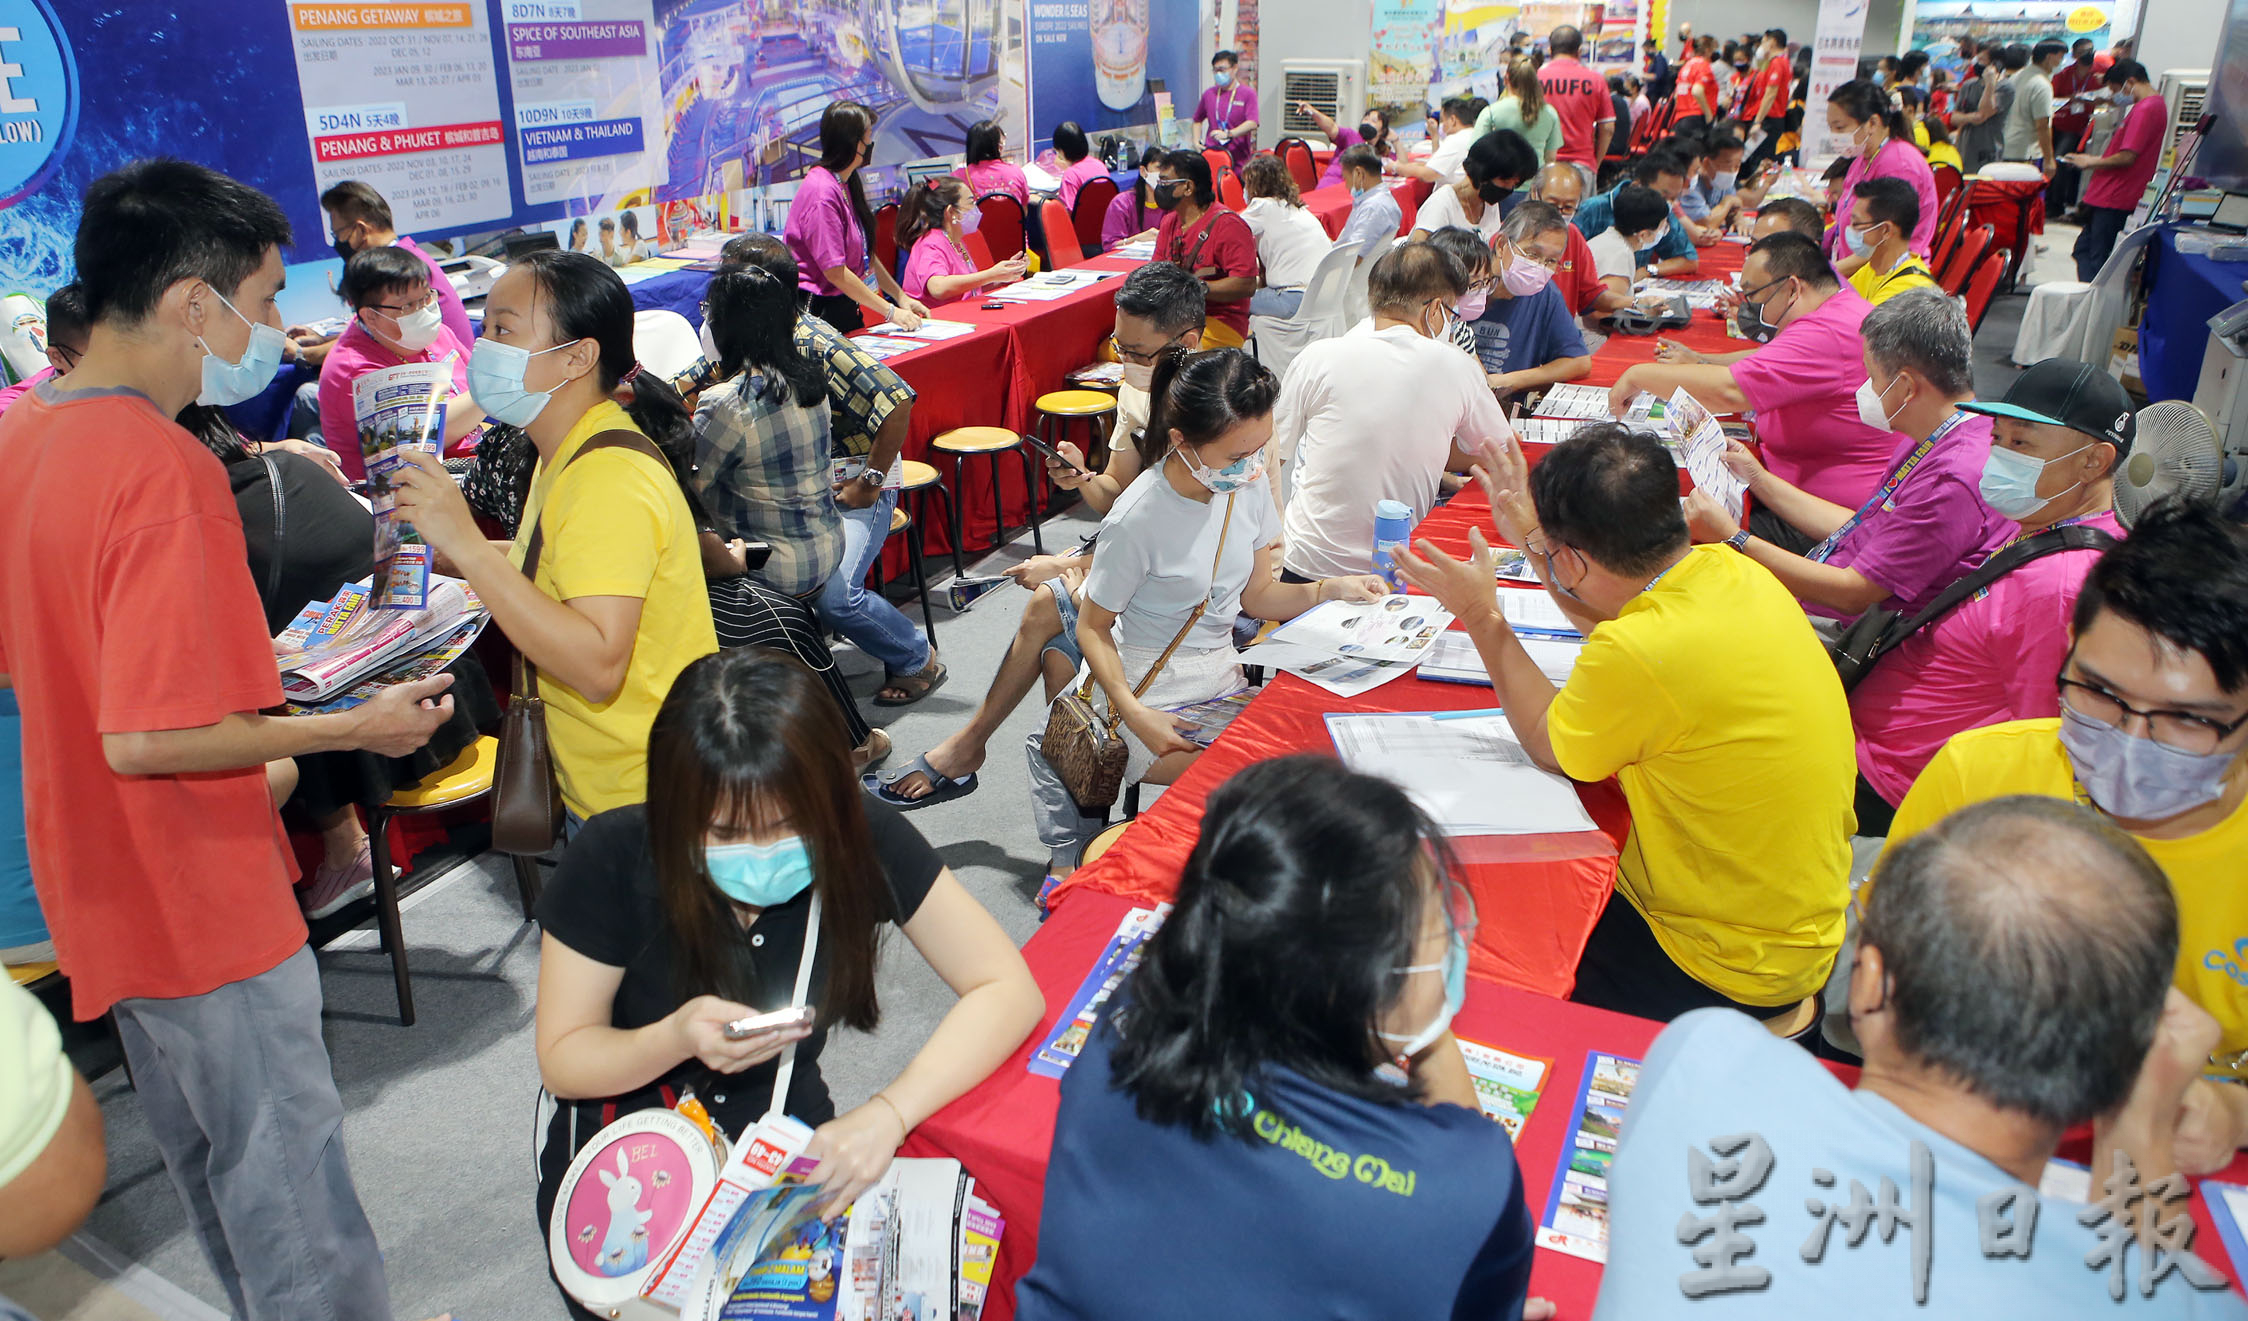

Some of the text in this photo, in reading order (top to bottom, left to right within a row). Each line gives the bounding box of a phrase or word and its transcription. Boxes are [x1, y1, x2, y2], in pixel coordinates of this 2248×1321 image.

[300, 8, 420, 26] PENANG GETAWAY
[512, 4, 545, 18] 8D7N
[300, 36, 336, 49] SAILING
[512, 24, 640, 42] SPICE OF SOUTHEAST ASIA
[1541, 78, 1592, 95] MUFC
[320, 112, 361, 131] 5D4N
[520, 108, 558, 124] 10D9N
[525, 122, 633, 146] VIETNAM & THAILAND
[320, 131, 442, 157] PENANG & PHUKET
[322, 165, 356, 180] SAILING
[406, 160, 424, 171] NOV
[1894, 455, 1920, 480] MATTA
[1915, 440, 1935, 458] FAIR
[316, 604, 343, 636] PERAK
[326, 611, 352, 635] MATTA
[636, 1116, 676, 1130] GETTING
[1254, 1110, 1416, 1196] Chiang Mai
